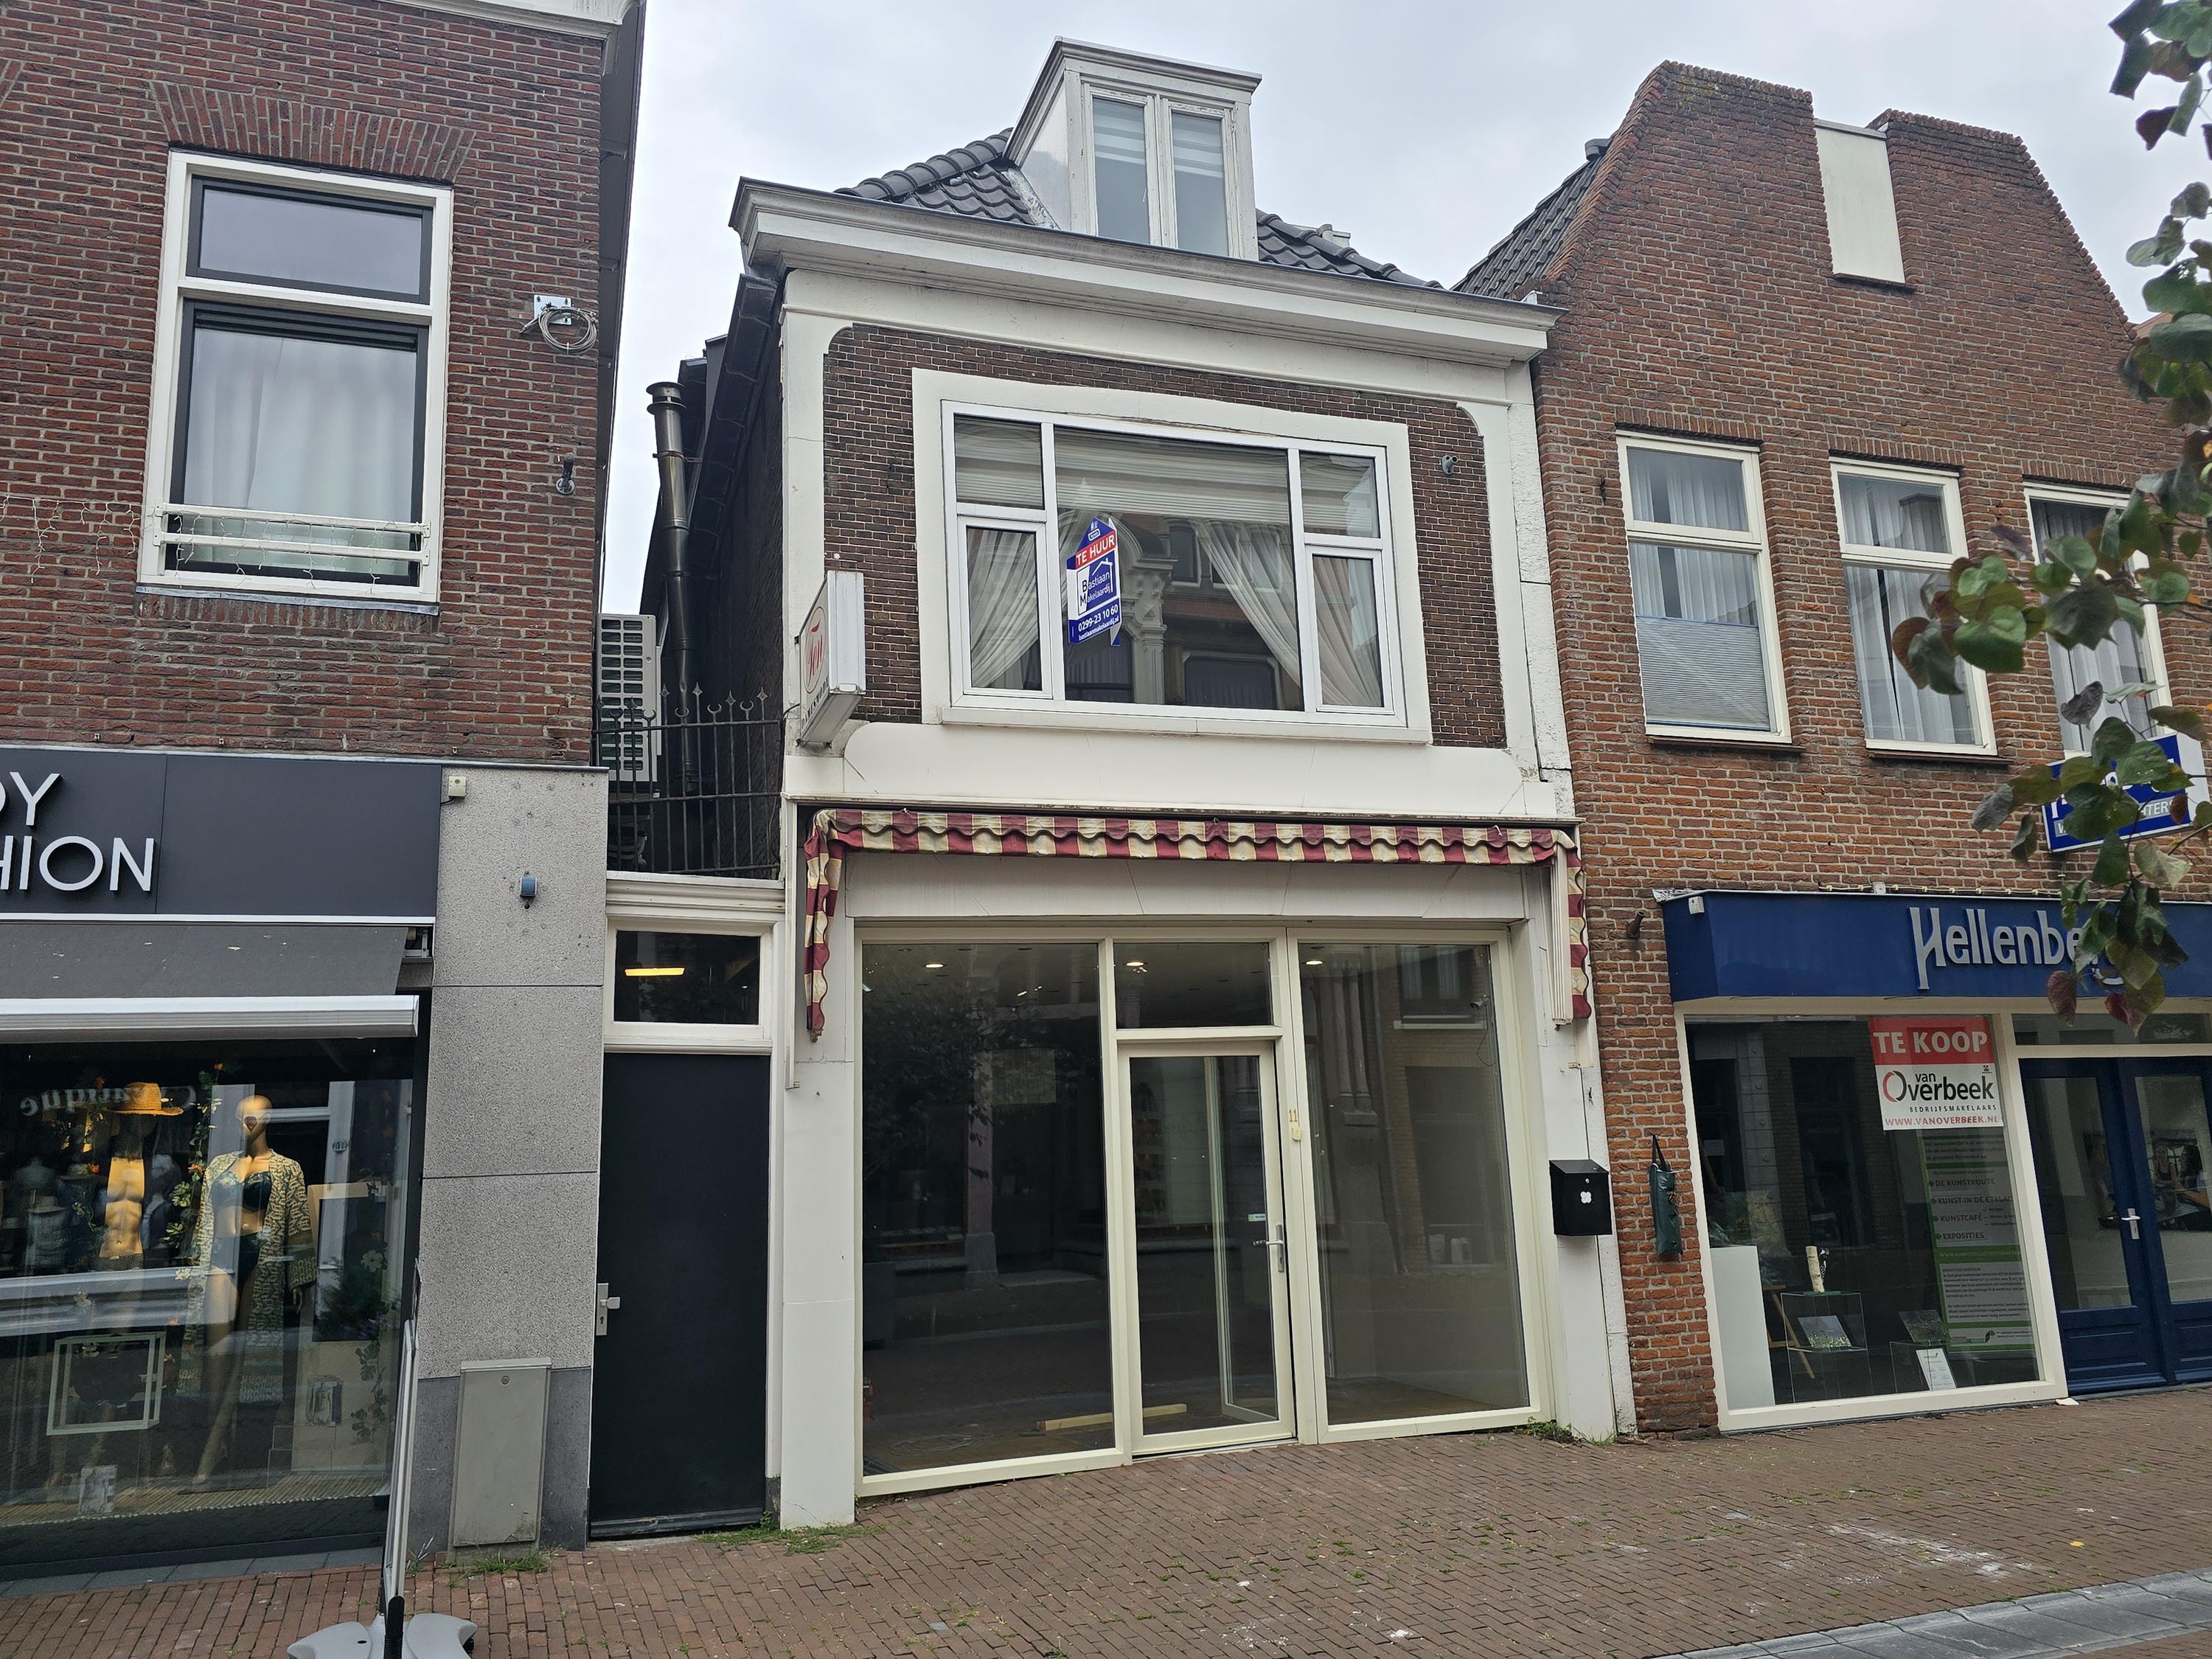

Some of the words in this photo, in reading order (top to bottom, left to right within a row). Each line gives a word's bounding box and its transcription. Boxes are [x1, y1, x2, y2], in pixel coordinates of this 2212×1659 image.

[1077, 550, 1088, 566] TE
[1090, 535, 1115, 559] HUUR
[1082, 571, 1110, 593] Bastiaan
[1080, 582, 1110, 607] Makelaardij
[1078, 613, 1102, 632] 0299-23
[1102, 608, 1110, 619] 10
[1110, 604, 1119, 615] 60
[0, 771, 61, 827] Y
[1908, 907, 2125, 990] Hellenbe
[1873, 1032, 1907, 1054] TE
[1913, 1031, 1988, 1054] KOOP
[1882, 1070, 1994, 1102] Overbeek
[1915, 1073, 1936, 1082] van
[1288, 1108, 1298, 1122] 11
[1910, 1104, 1997, 1113] BEDRIJFSMAKELAARS
[1885, 1115, 2000, 1126] WWW.VANOVERBEEK.NL
[1942, 1231, 1985, 1239] EXPOSITIES
